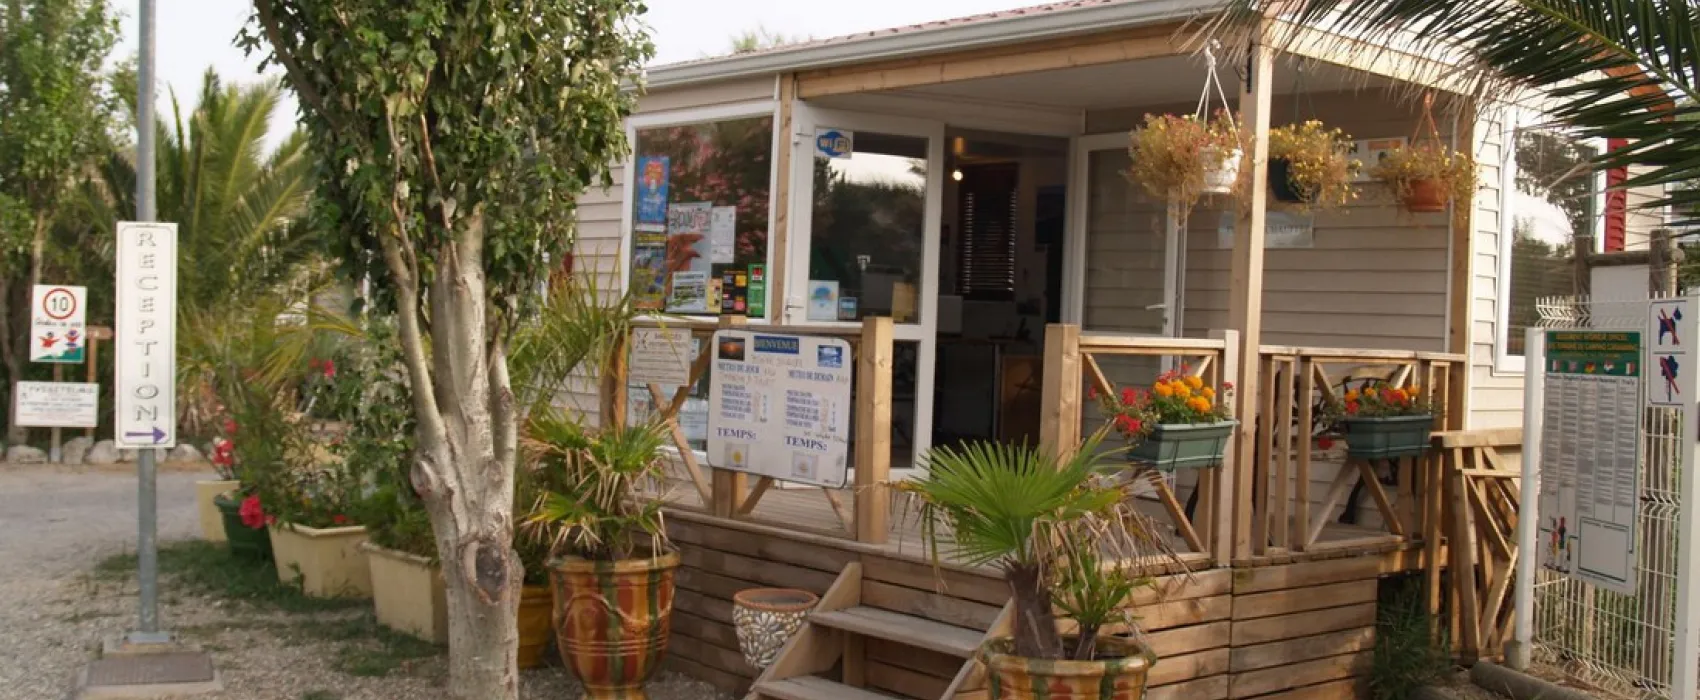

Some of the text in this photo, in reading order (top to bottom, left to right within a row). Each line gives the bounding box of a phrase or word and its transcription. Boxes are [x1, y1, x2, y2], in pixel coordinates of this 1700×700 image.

[51, 296, 69, 312] 10
[134, 232, 160, 421] RECEPTION
[755, 338, 798, 350] BIENVENUE
[716, 426, 757, 440] TEMPS:
[785, 436, 828, 451] TEMPS:
